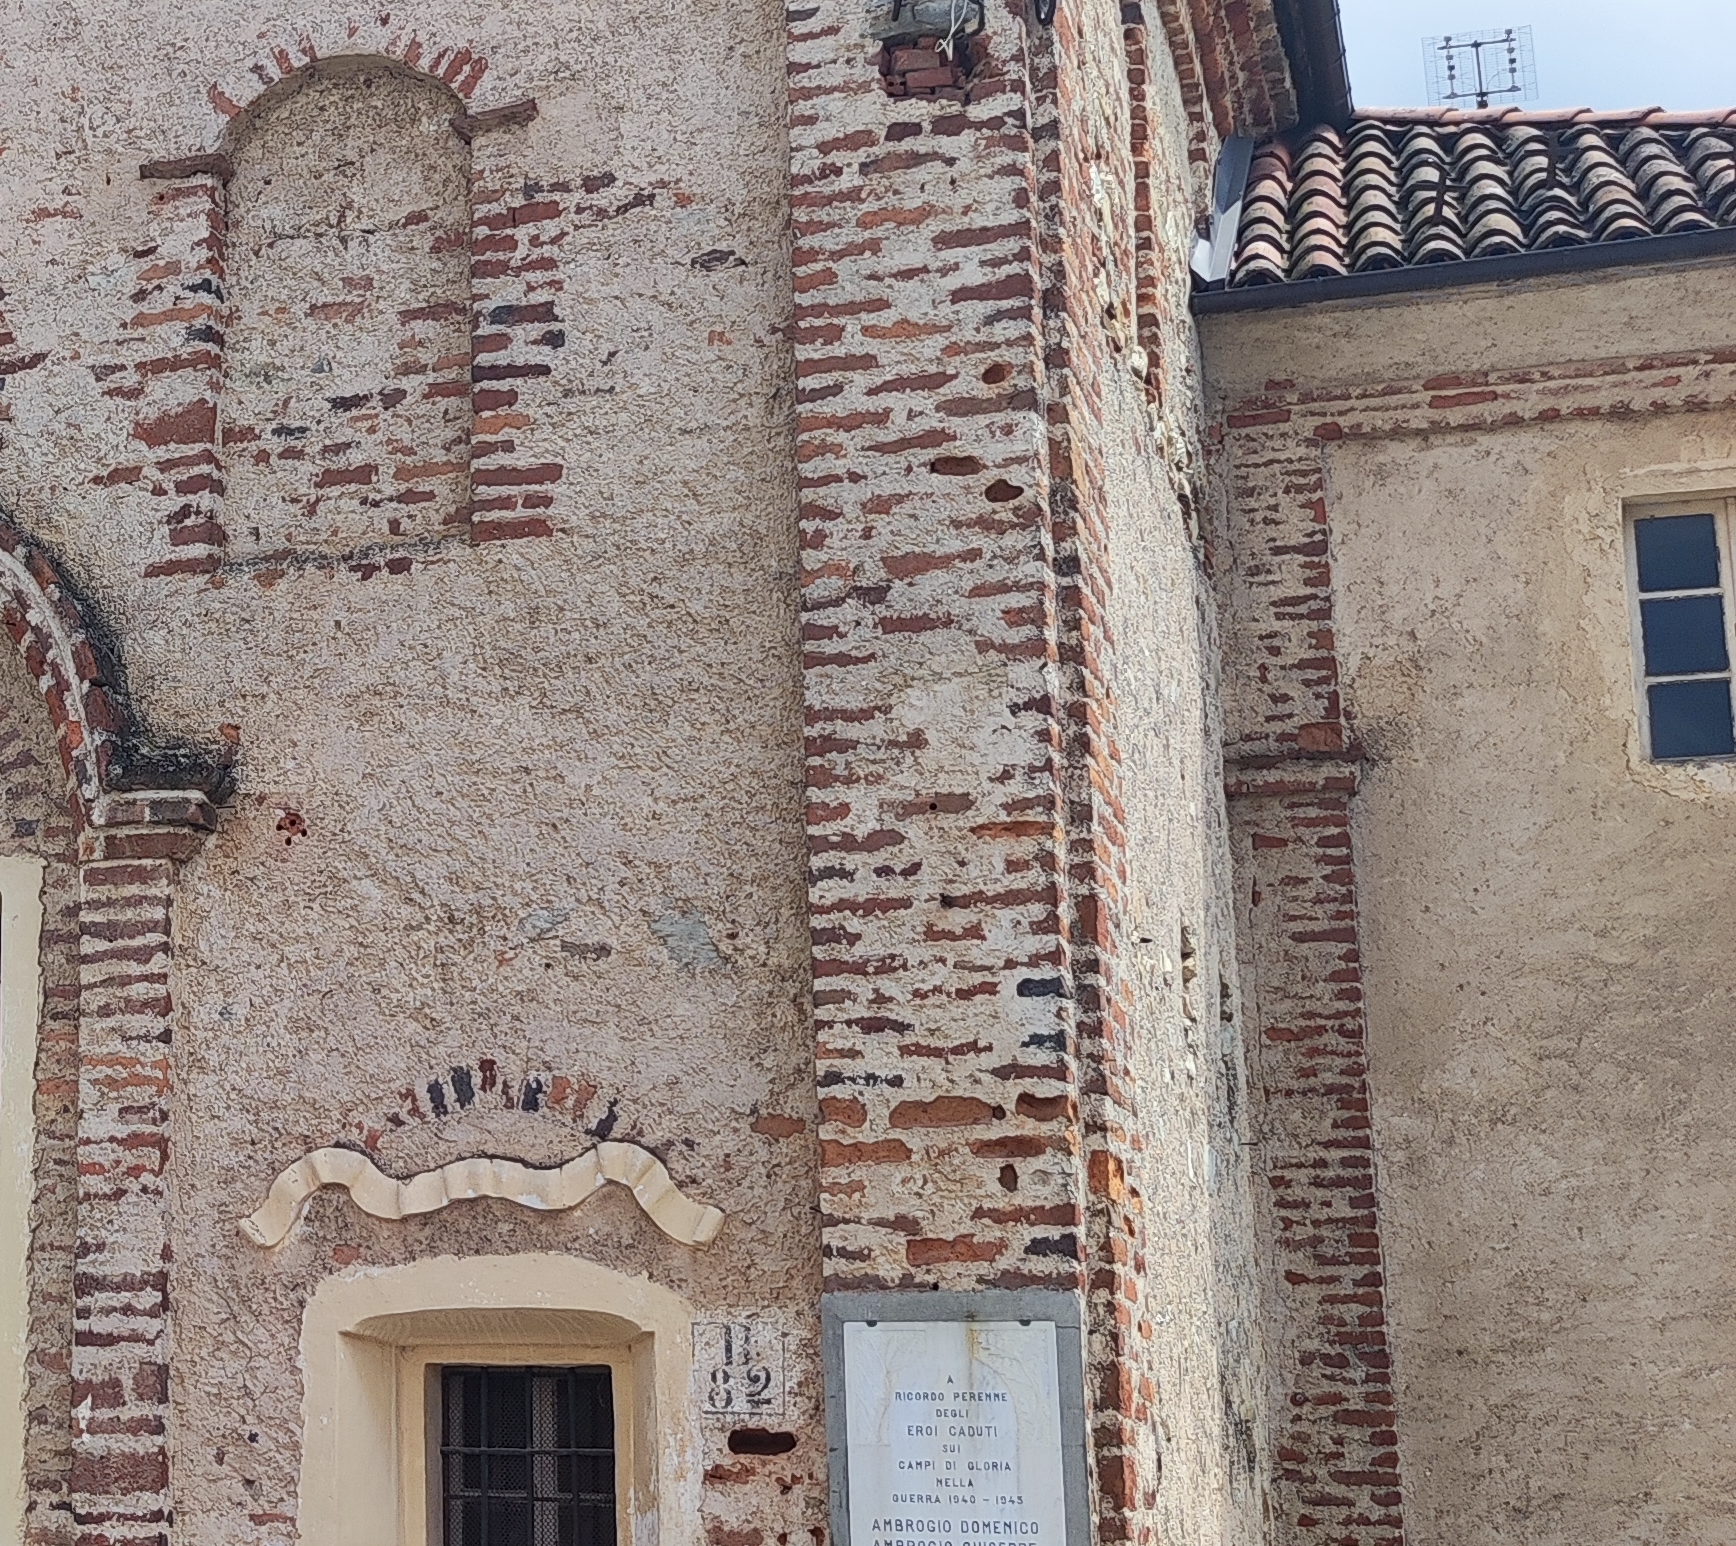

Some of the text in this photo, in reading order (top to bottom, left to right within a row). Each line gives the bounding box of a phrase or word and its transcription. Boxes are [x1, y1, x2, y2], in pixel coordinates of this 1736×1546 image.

[946, 1374, 955, 1385] A
[894, 1391, 1008, 1403] RICORDO PERENNE
[935, 1408, 969, 1418] DEGLI
[907, 1425, 998, 1437] EROI CADUTI
[941, 1444, 961, 1454] SUI
[898, 1460, 1012, 1471] CAMPI DI GLORIA
[935, 1477, 974, 1488] NELLA
[892, 1493, 942, 1504] GUERRA
[948, 1494, 976, 1504] 1940
[995, 1495, 1024, 1505] 1945
[871, 1518, 1039, 1535] AMBROGIO DOMENICO
